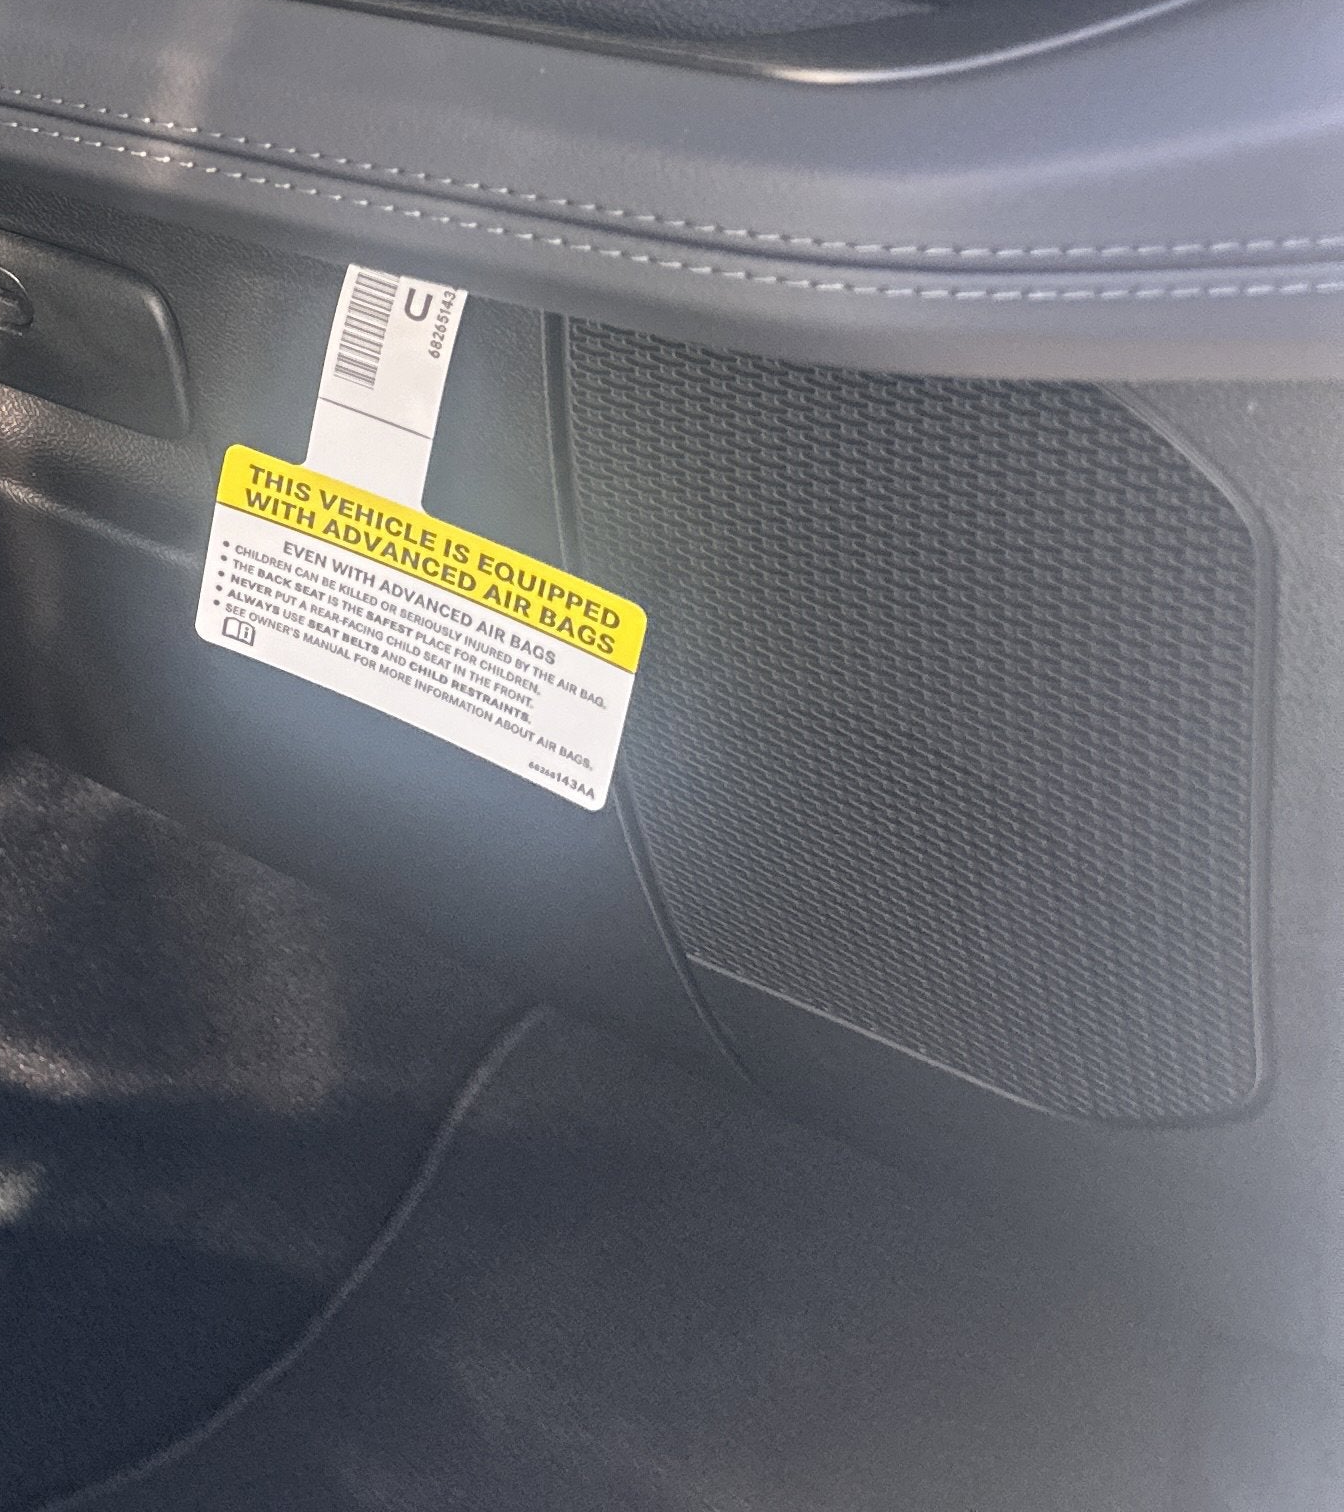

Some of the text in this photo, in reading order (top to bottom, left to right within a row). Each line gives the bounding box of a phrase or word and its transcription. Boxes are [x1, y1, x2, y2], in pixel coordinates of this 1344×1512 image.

[404, 287, 433, 322] U
[428, 290, 456, 359] 68265143
[244, 487, 616, 655] WITH ADVANCED AIR BAGS
[248, 463, 621, 630] THIS VEHICLE IS EQUIPPED
[282, 540, 556, 666] EVEN WITH ADVANCED AIR BAGS
[224, 602, 593, 772] SEE OWNER'S MANUAL FOR MORE INFORMATION ABOUT AIR BAGS.
[226, 588, 532, 725] ALWAYS USE SEAT BELTS AND CHILD RESTRAINTS.
[230, 573, 534, 709] NEVER PUT A REAR-FACING CHILD SEAT IN THE FRONT.
[232, 558, 541, 696] THE BACK SEAT IS THE SAFEST PLACE FOR CHILDREN.
[234, 544, 293, 574] CHILDREN
[294, 566, 320, 584] CAN
[321, 576, 337, 591] BE
[338, 583, 378, 607] KILLED
[380, 600, 398, 616] OR
[399, 608, 463, 642] SERIOUSLY
[463, 635, 513, 665] INJURED
[514, 658, 531, 673] BY
[532, 665, 556, 685] THE
[556, 678, 578, 696] AIR
